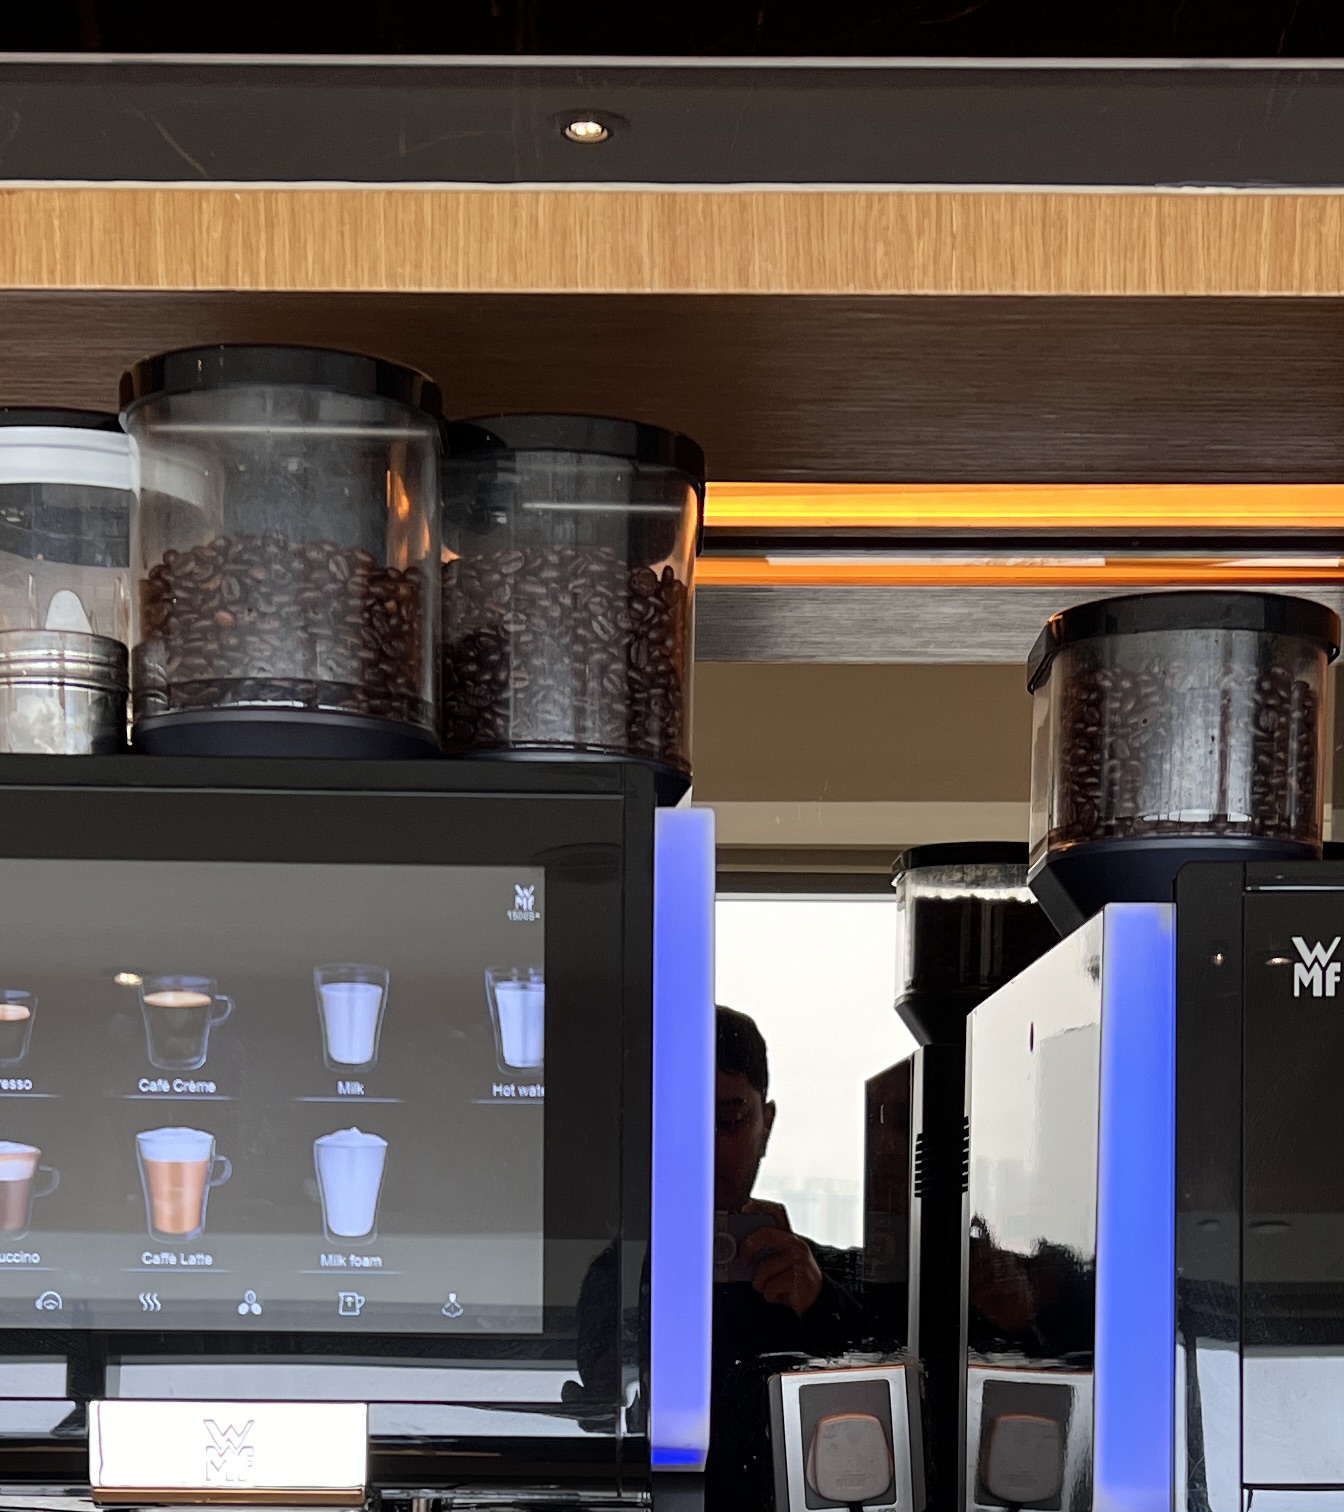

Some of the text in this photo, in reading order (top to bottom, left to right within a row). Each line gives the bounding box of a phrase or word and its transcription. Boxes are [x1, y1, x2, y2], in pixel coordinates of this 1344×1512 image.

[1292, 936, 1342, 997] WMF
[172, 1078, 217, 1094] Crème
[337, 1081, 365, 1095] Milk
[492, 1082, 516, 1097] Hot
[179, 1252, 213, 1266] Latte
[320, 1253, 383, 1267] Milk foam
